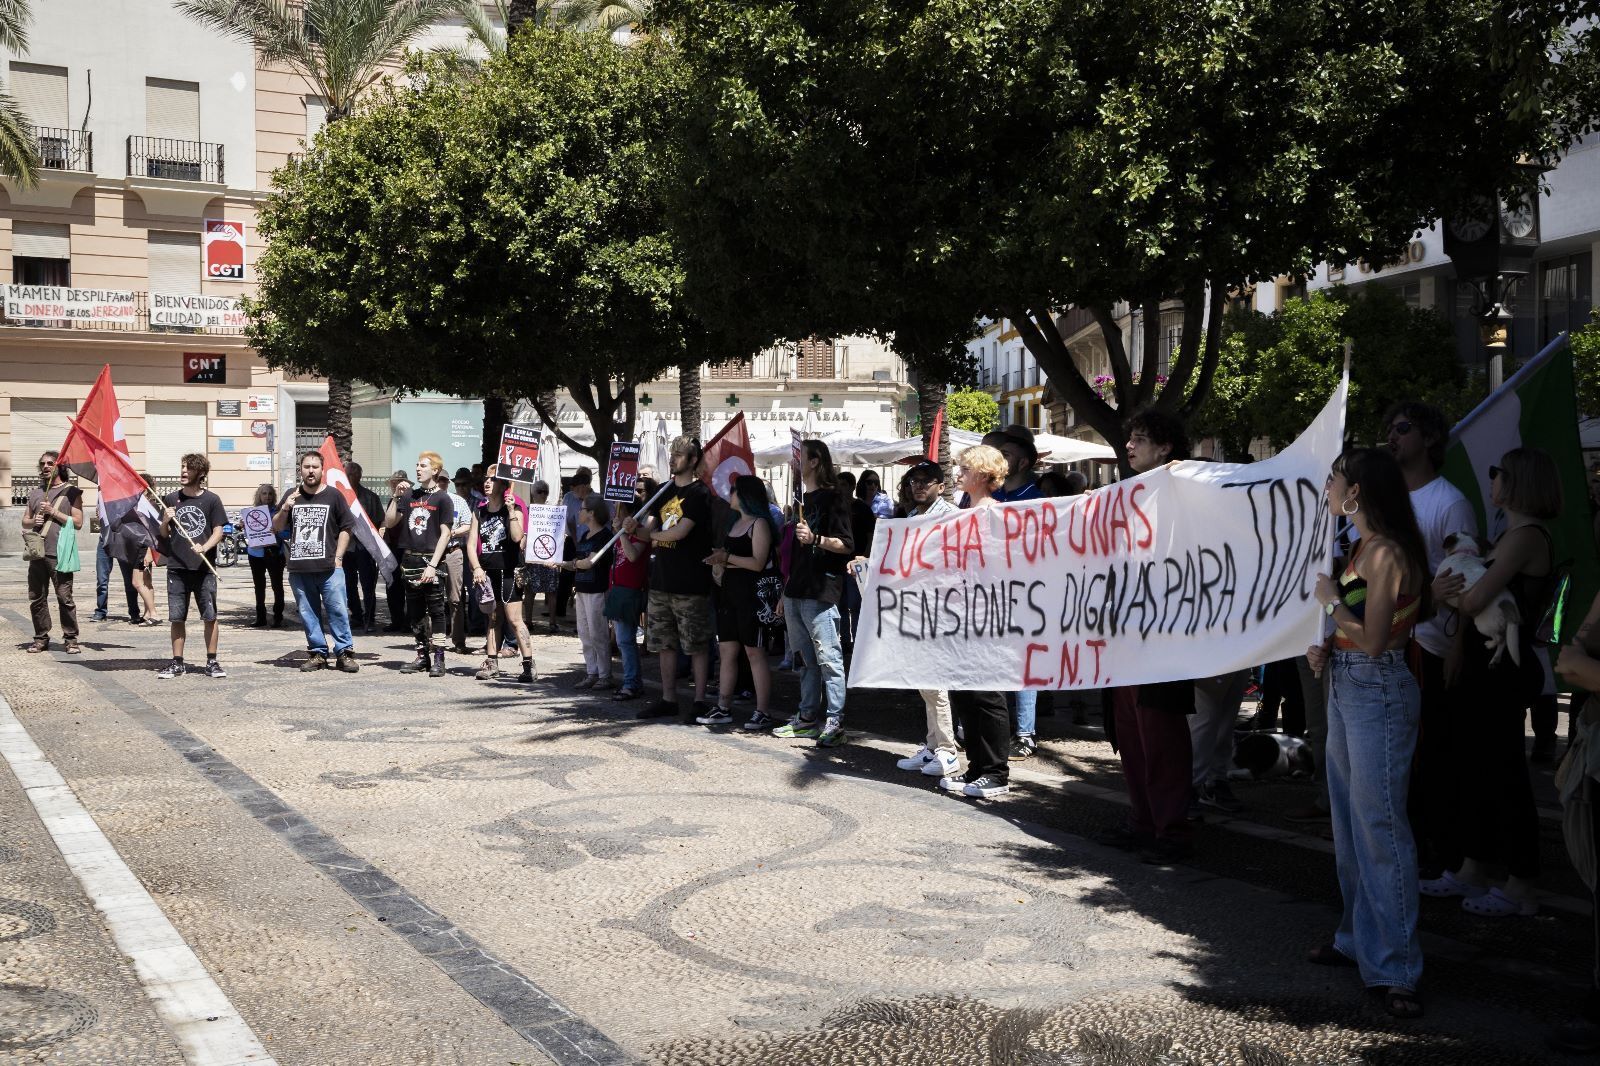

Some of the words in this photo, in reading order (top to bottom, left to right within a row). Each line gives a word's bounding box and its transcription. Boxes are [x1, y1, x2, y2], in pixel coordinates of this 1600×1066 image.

[210, 263, 242, 276] CGT
[9, 285, 61, 301] MAMEN
[9, 302, 22, 315] EL
[24, 304, 65, 317] DINERO
[66, 309, 76, 317] DE
[77, 309, 91, 318] LOS
[154, 295, 230, 311] BIENVENIDOS
[156, 311, 203, 325] CIUDAD
[207, 316, 220, 325] DEL
[189, 358, 221, 370] CNT
[751, 411, 804, 422] PUERTA
[880, 514, 985, 578] LUCHA
[1003, 502, 1057, 568] POR
[1069, 484, 1152, 556] UNAS
[1159, 543, 1237, 636] PARA
[1022, 639, 1111, 688] C.N.T.
